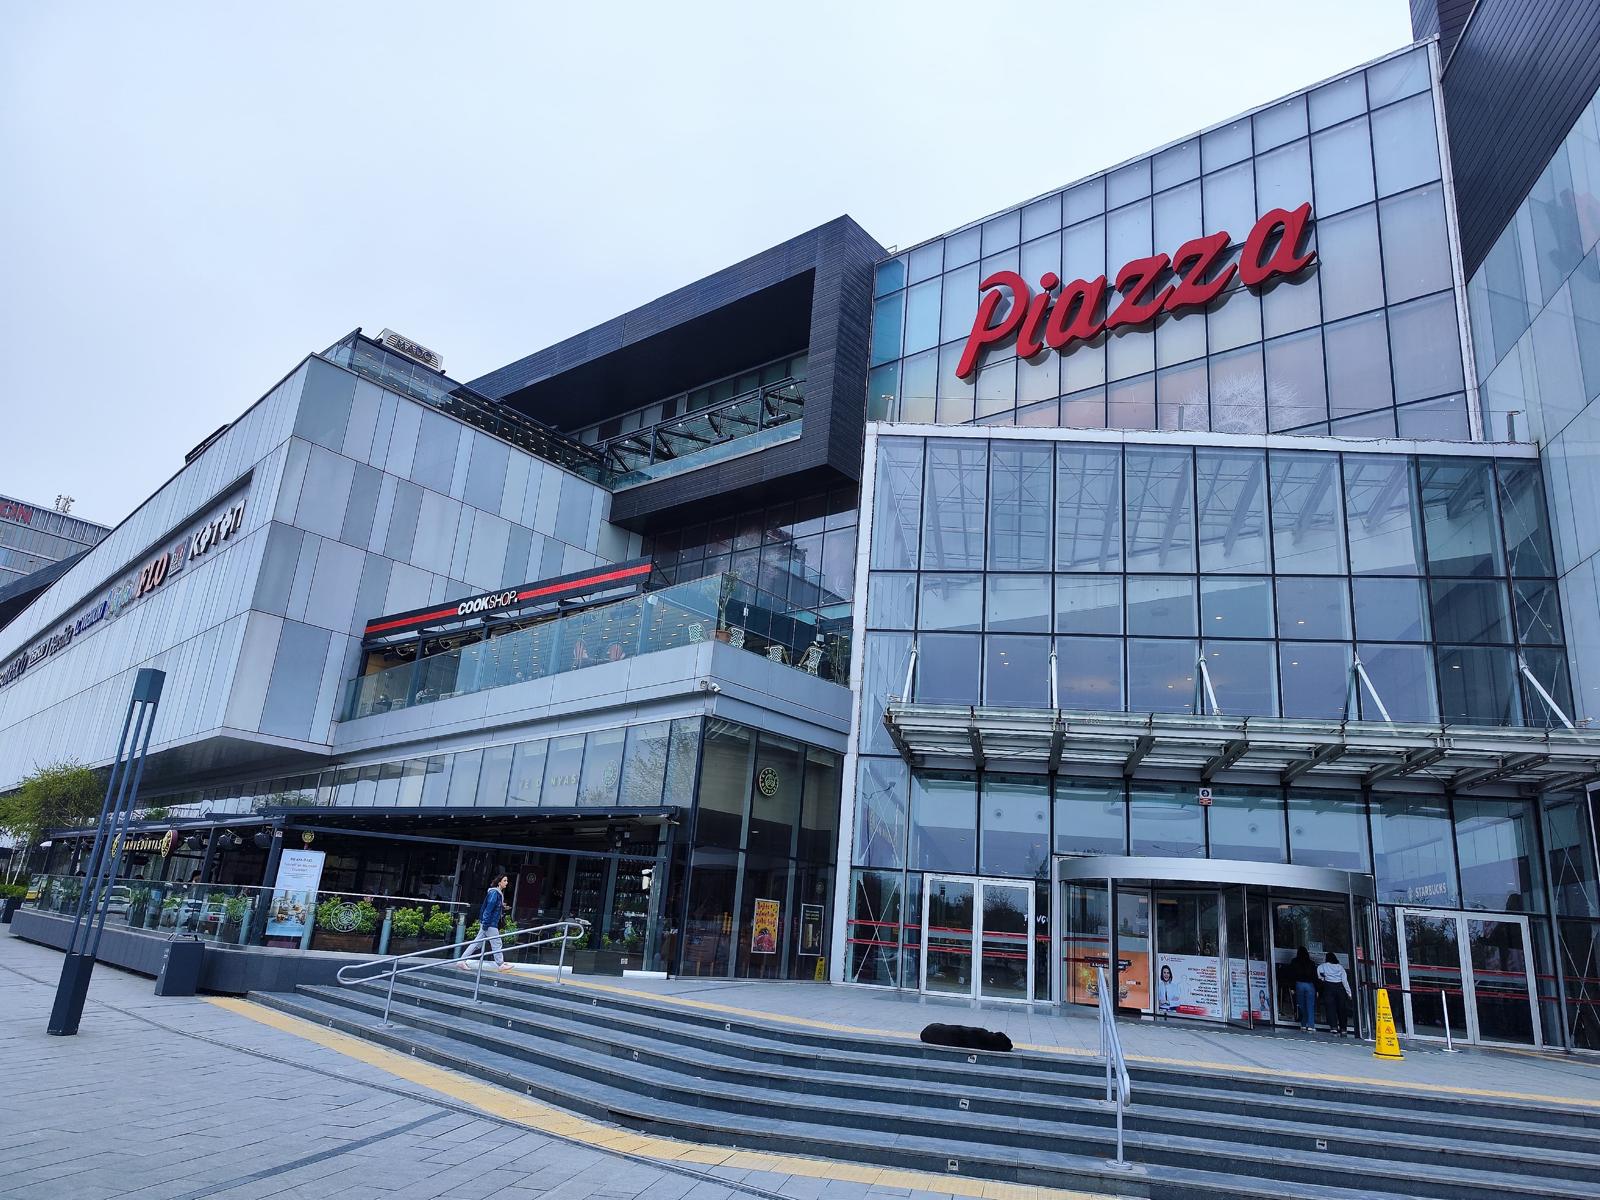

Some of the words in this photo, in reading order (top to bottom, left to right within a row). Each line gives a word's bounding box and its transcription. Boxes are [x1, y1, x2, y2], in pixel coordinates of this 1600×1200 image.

[956, 201, 1317, 379] Piazza
[396, 338, 432, 361] MADO
[136, 553, 170, 597] FLO
[1415, 882, 1447, 898] STARBUCKS
